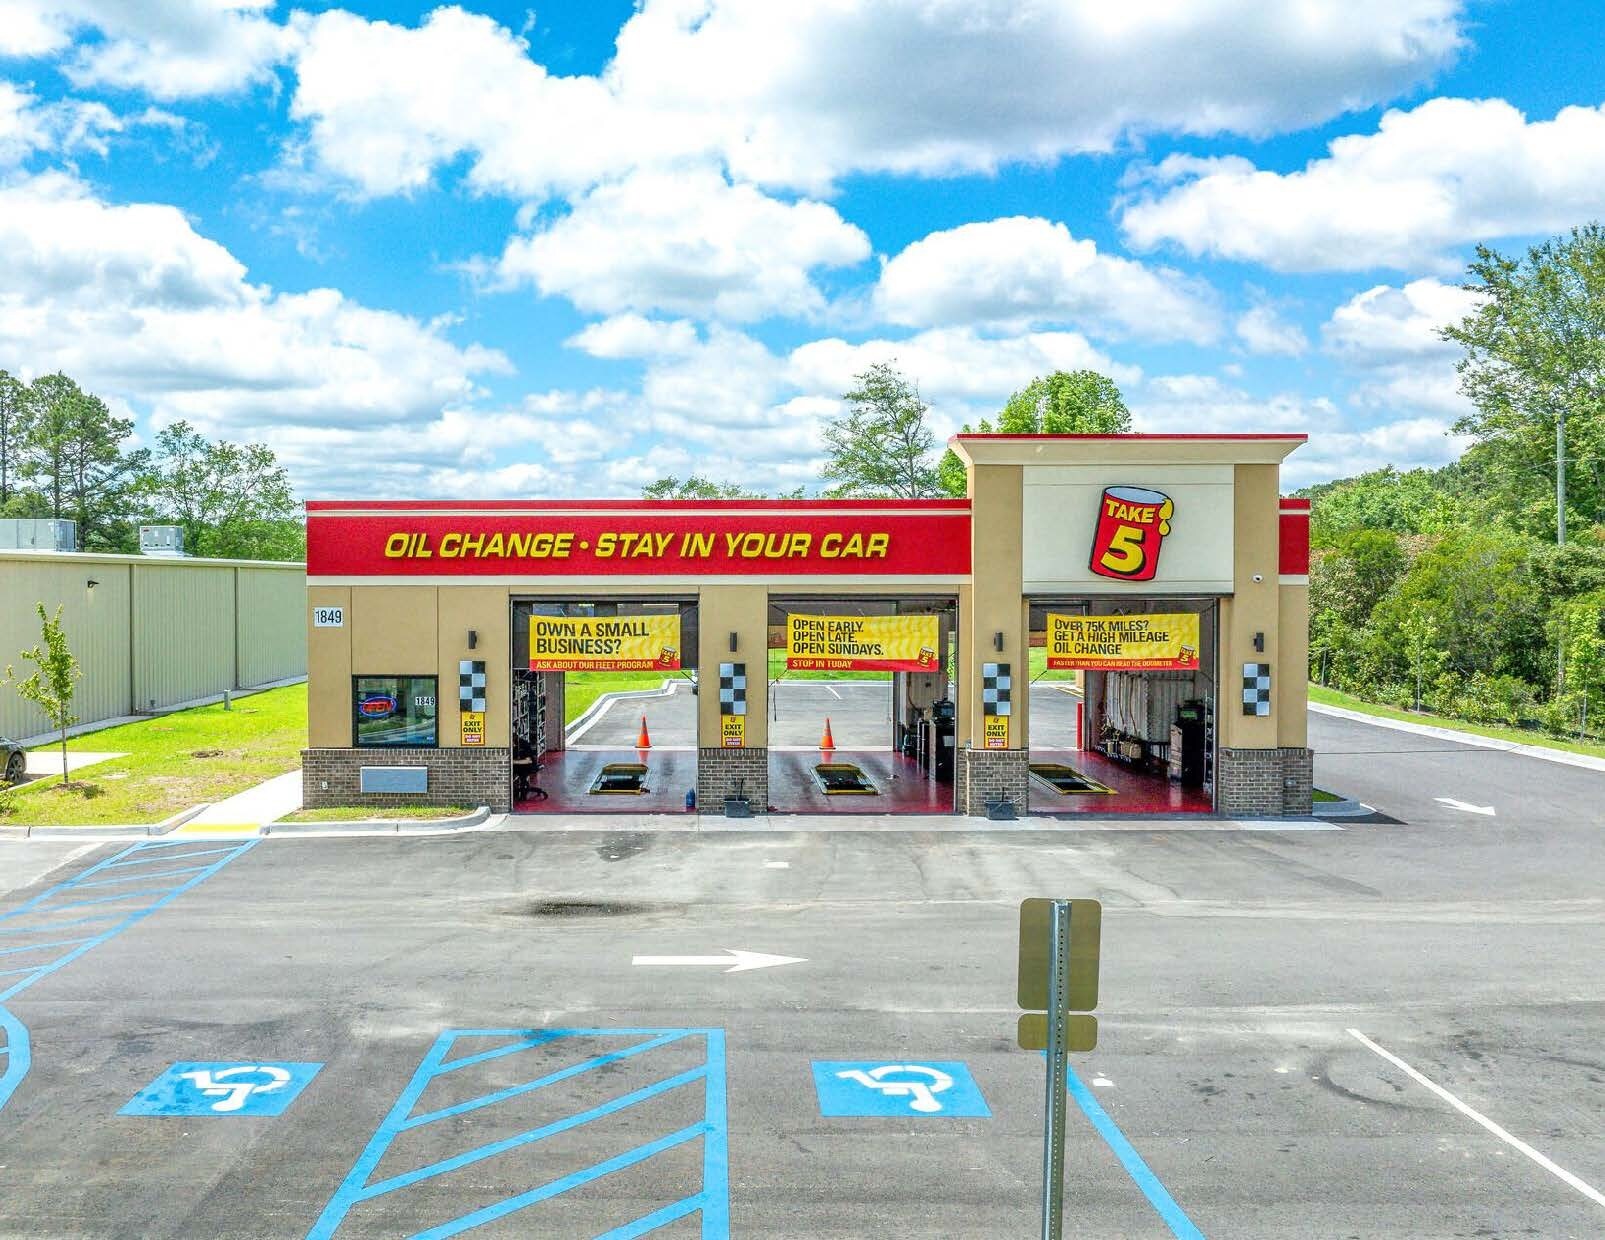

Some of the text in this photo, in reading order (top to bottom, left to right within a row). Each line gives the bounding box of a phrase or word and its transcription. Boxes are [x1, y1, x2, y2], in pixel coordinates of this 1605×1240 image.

[1105, 499, 1156, 524] TAKE
[384, 532, 890, 558] OIL CHANGE STAY IN YOUR CAR
[1100, 524, 1146, 573] 5
[315, 610, 342, 624] 1849
[536, 621, 650, 637] OWN A SMALL
[793, 618, 864, 633] OPEN EARLY.
[1054, 618, 1150, 632] OVER 75K MILES?
[793, 631, 858, 643] OPEN LATE.
[1054, 631, 1170, 643] GET A HIGH MILEAGE
[536, 638, 622, 655] BUSINESS?
[793, 642, 884, 656] OPEN SUNDAYS.
[1054, 642, 1123, 655] OIL CHANGE
[536, 660, 551, 669] ASK
[551, 660, 579, 669] ABOUT
[579, 660, 594, 669] OUR
[617, 660, 654, 669] PROGRAM
[792, 659, 853, 668] STOP IN TODAY
[416, 697, 435, 706] 1849
